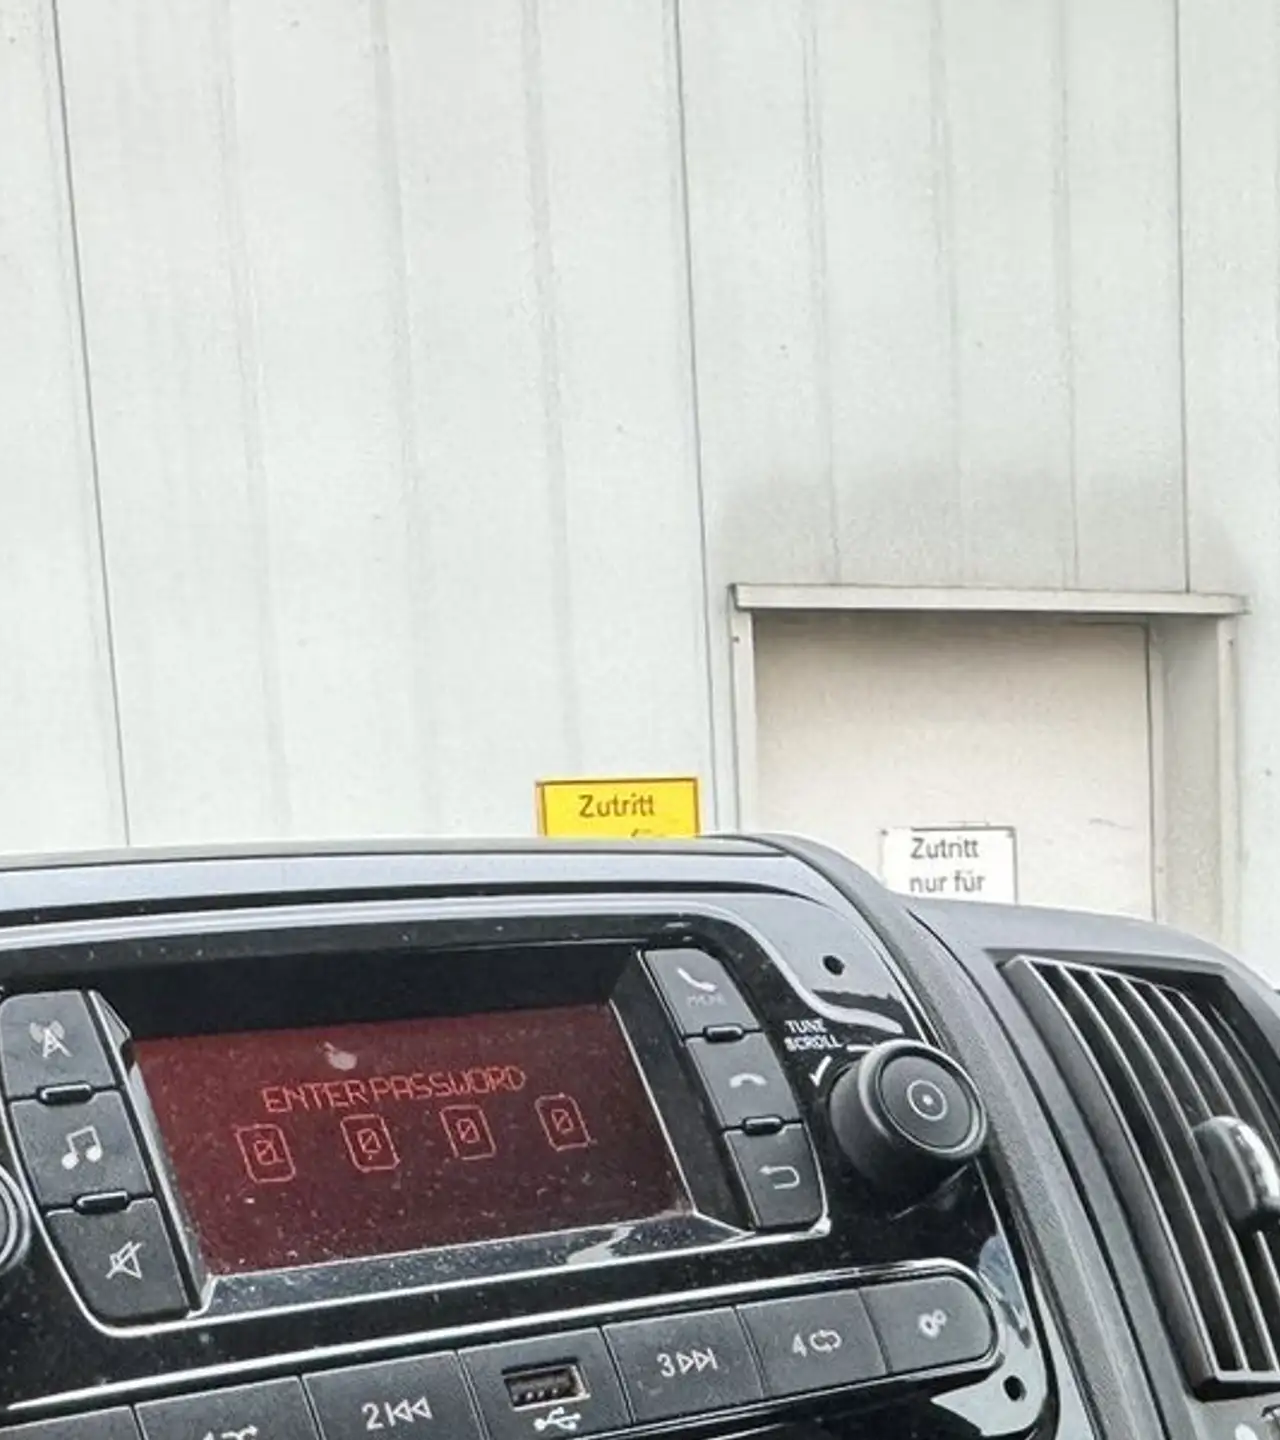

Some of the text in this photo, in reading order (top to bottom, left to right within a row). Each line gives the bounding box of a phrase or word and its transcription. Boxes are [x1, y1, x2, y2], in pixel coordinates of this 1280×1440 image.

[578, 792, 656, 819] Zutritt
[910, 837, 980, 859] Zutritt
[909, 868, 986, 893] nur für
[784, 1018, 828, 1034] TUNE
[784, 1034, 844, 1052] SCROLL
[792, 1332, 808, 1358] 4
[657, 1352, 675, 1378] 3
[361, 1402, 383, 1431] 2
